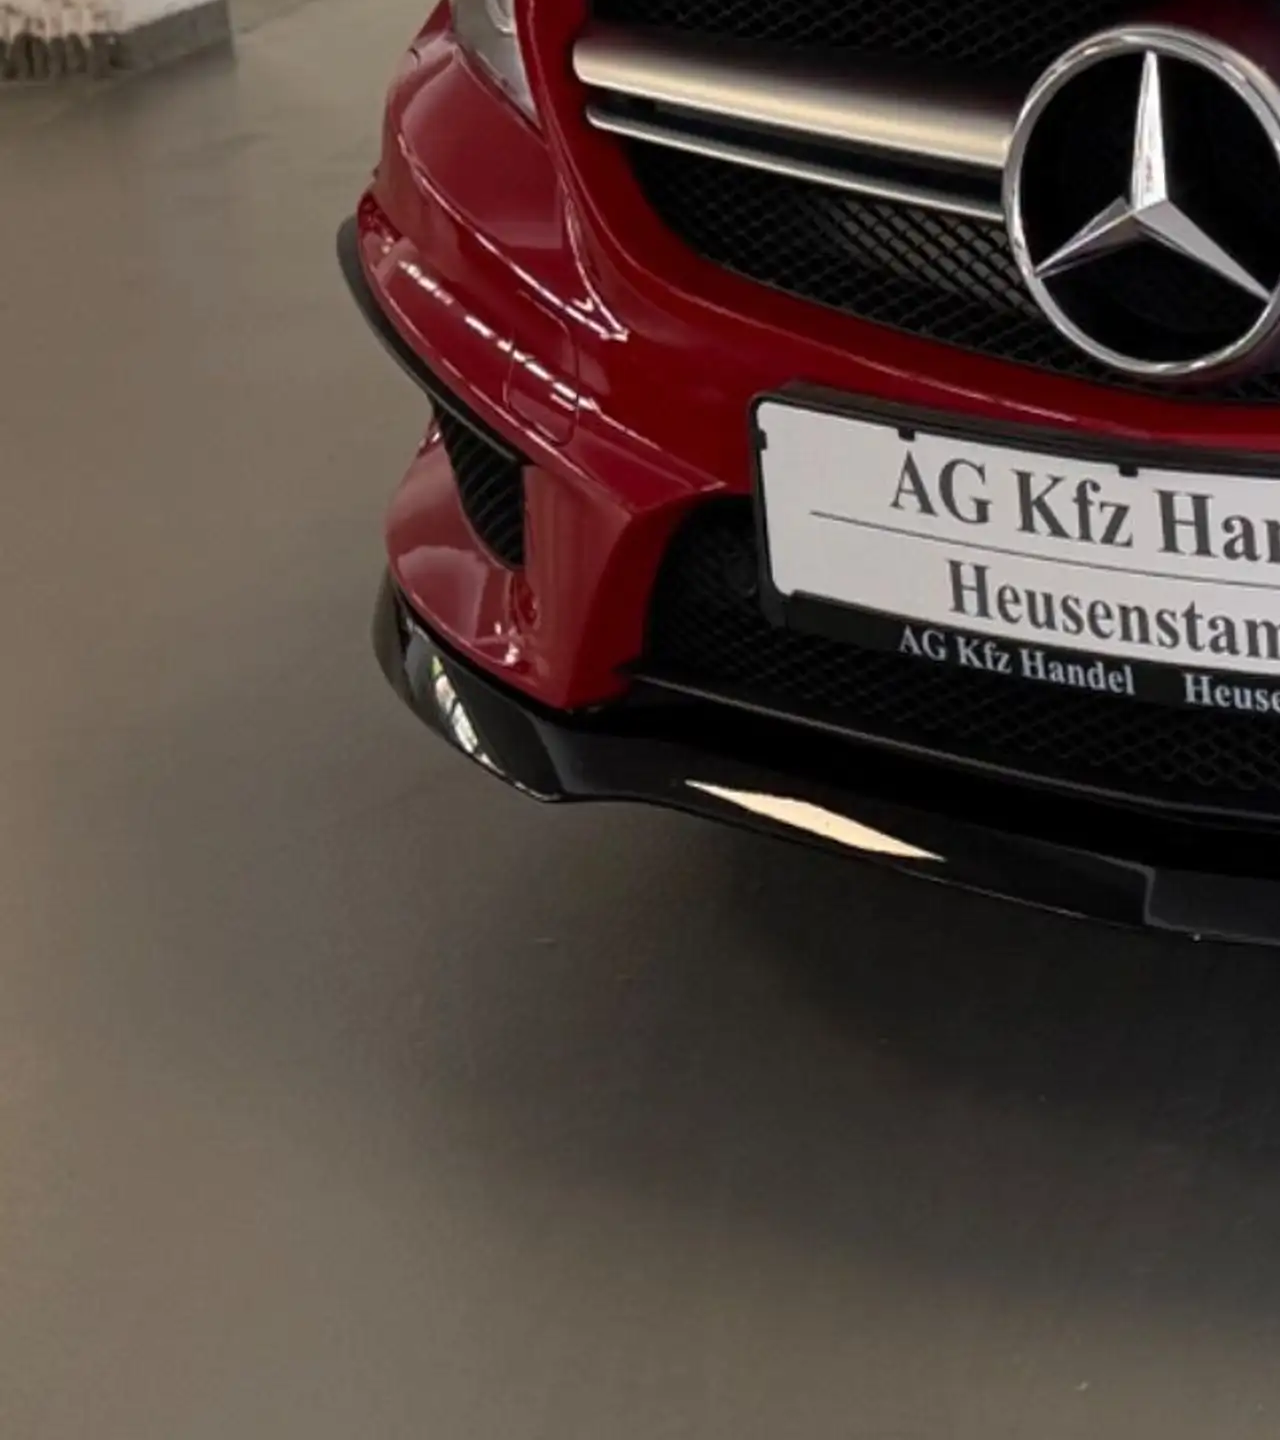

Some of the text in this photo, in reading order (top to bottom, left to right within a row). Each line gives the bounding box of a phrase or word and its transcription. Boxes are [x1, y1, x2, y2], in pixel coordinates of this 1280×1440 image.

[889, 449, 992, 524] AG
[1011, 469, 1134, 548] Kfz
[898, 625, 948, 660] AG
[955, 636, 1011, 675] Kfz
[1018, 648, 1136, 696] Handel
